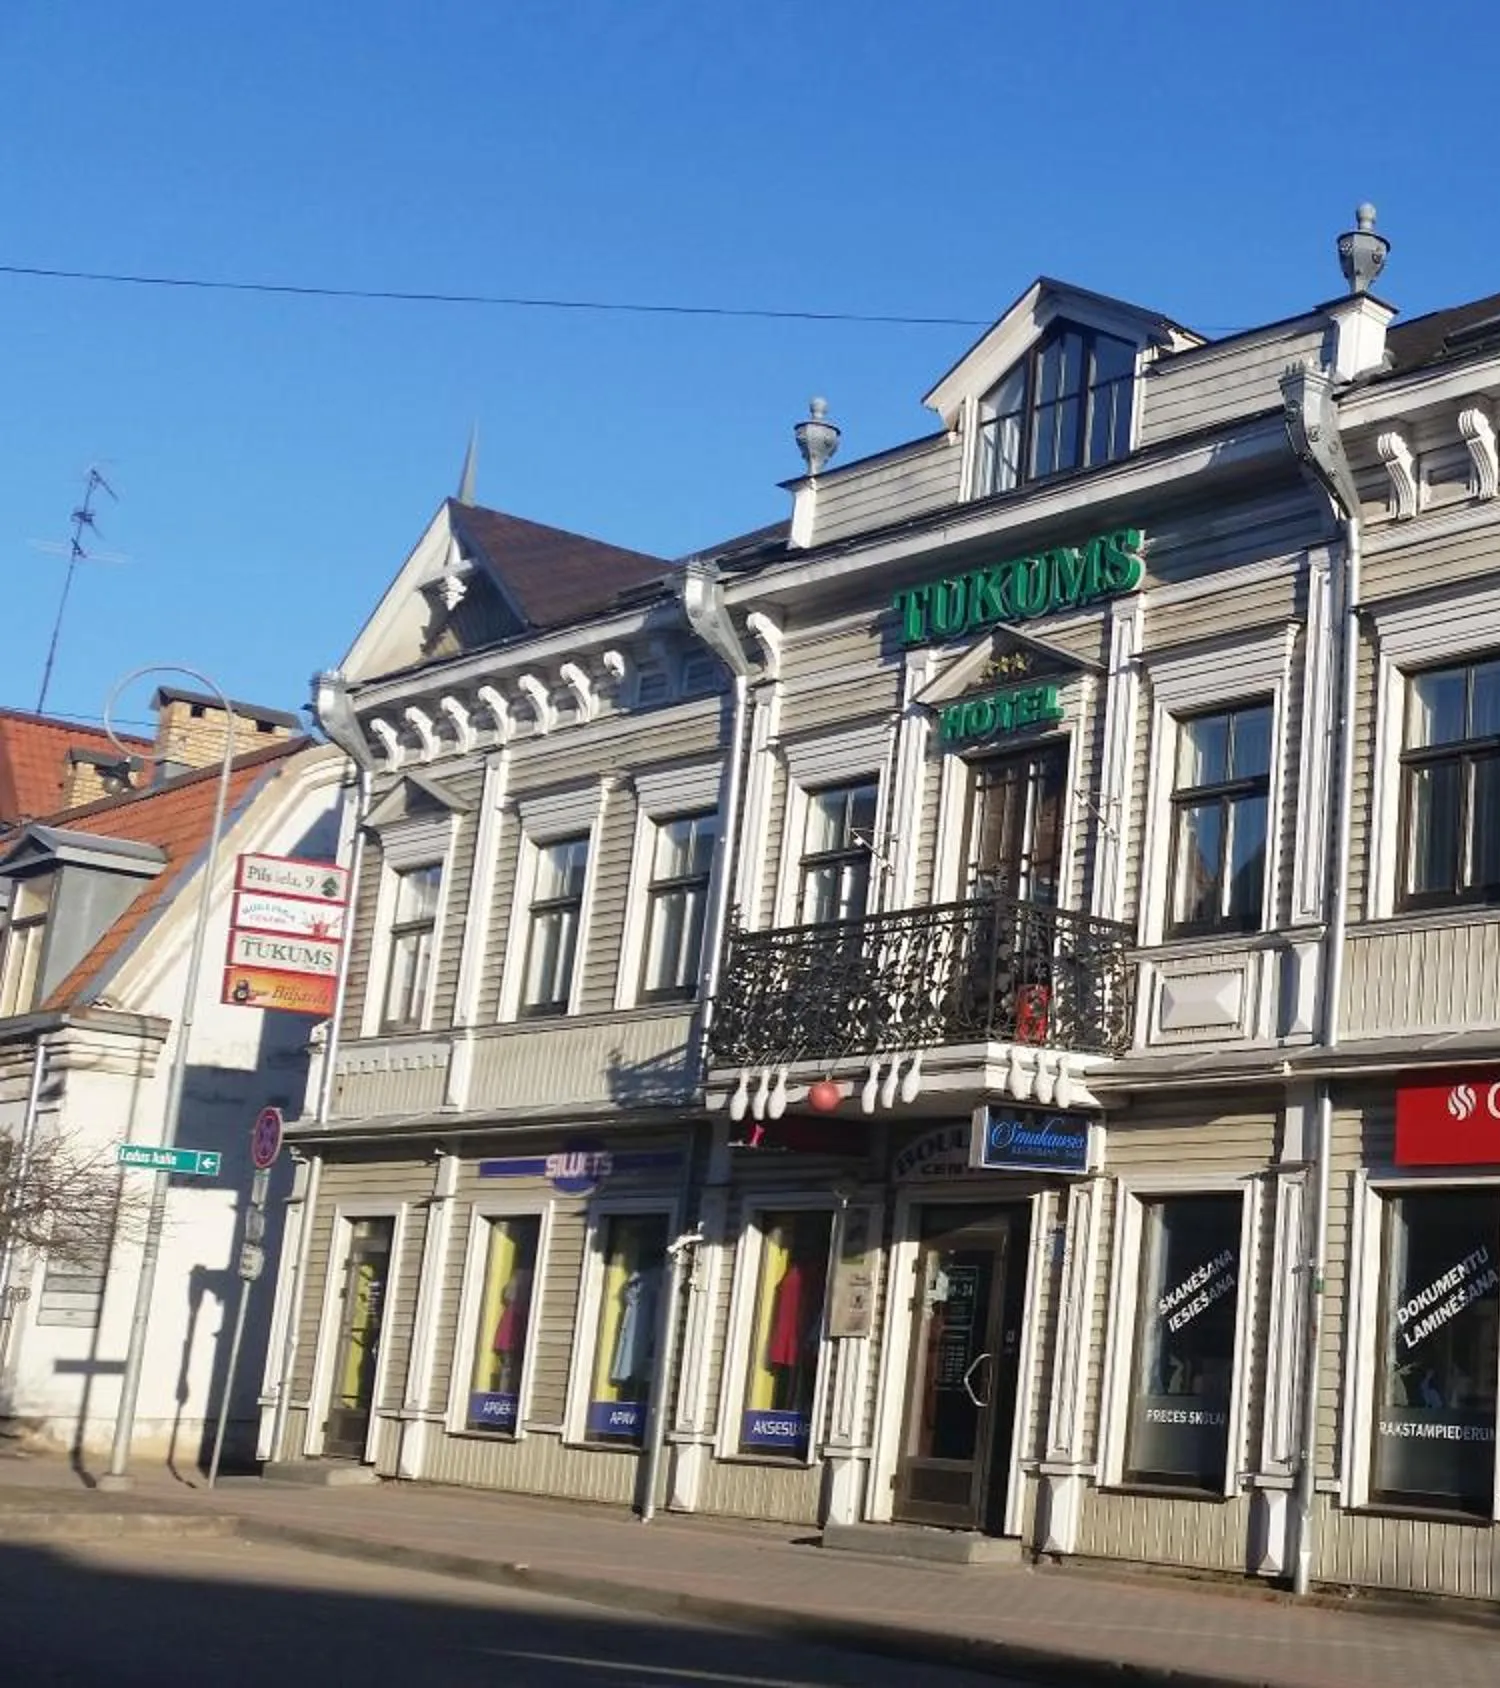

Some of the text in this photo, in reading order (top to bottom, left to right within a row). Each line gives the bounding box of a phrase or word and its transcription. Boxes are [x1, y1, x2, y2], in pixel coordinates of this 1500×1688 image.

[893, 528, 1146, 645] TUKUMS
[938, 684, 1065, 743] HOTEL
[241, 938, 333, 967] TUKUMS
[1397, 1246, 1490, 1325] DOKUMENTU
